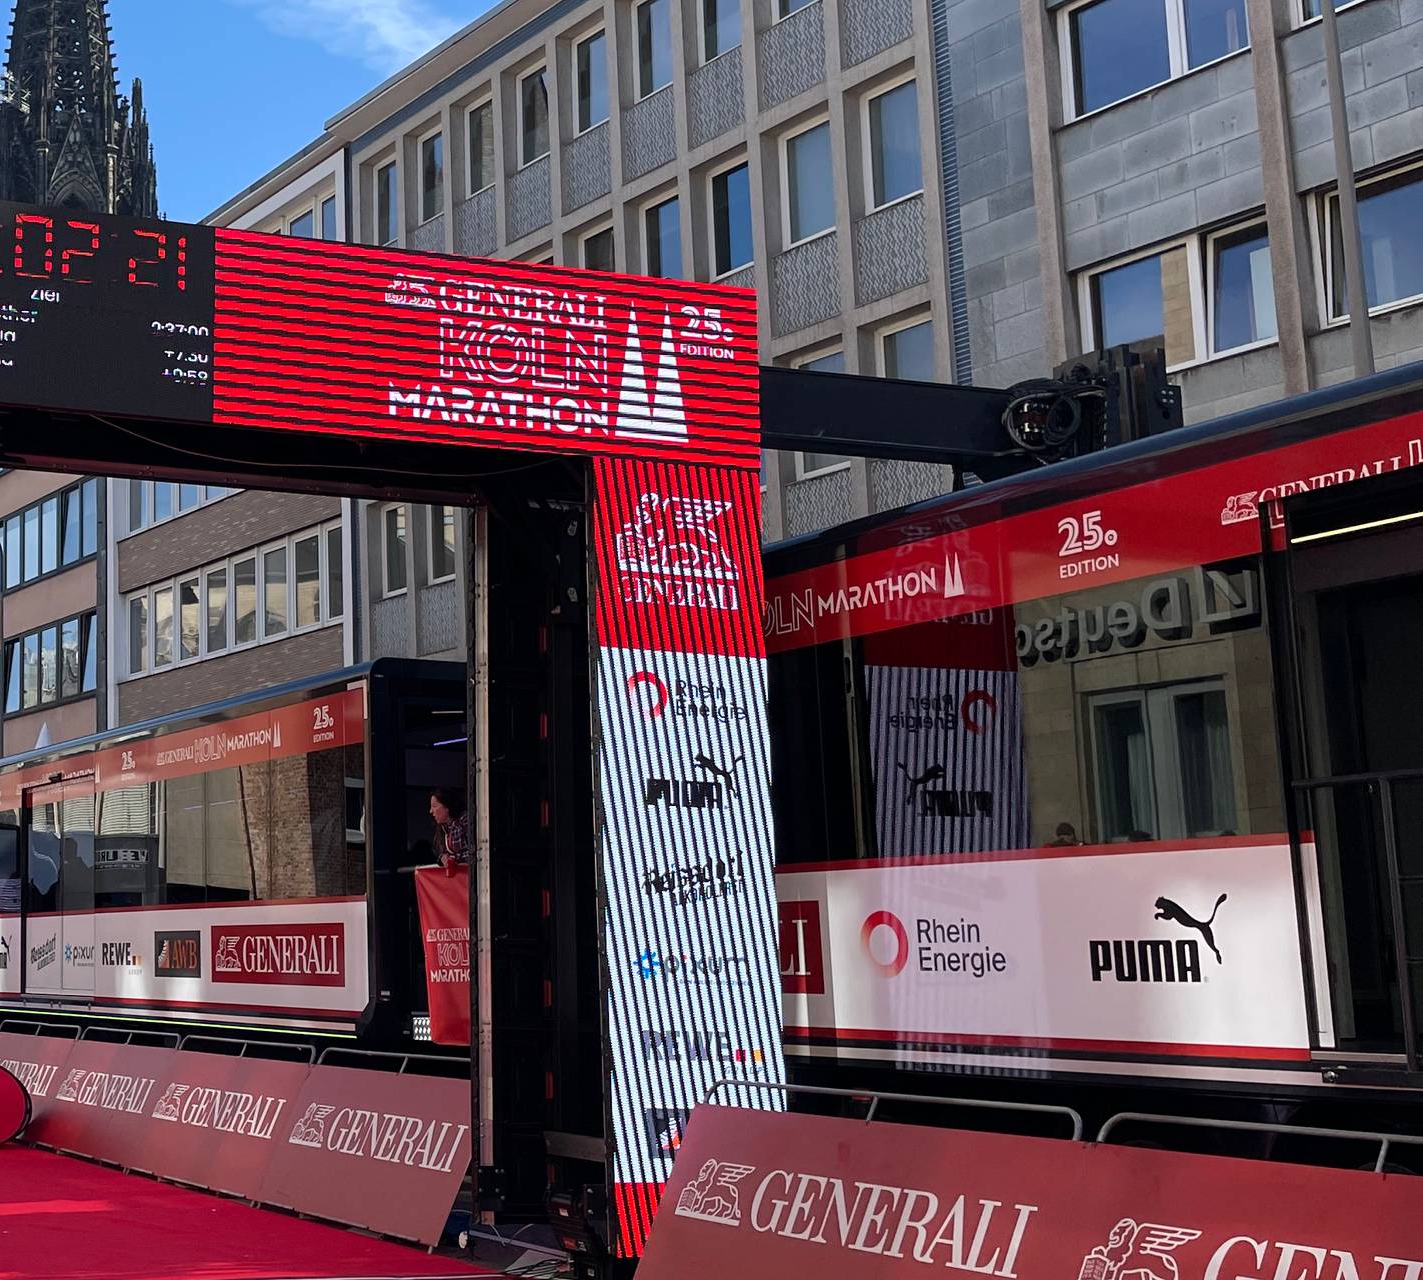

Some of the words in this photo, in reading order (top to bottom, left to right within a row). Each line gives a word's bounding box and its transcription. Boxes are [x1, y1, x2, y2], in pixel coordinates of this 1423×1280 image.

[439, 280, 607, 328] GENERALI
[681, 343, 735, 360] EDITION
[387, 382, 609, 437] MARATHON
[1060, 553, 1120, 579] EDITION
[618, 575, 739, 611] GENERALI
[817, 567, 937, 617] MARATHON
[677, 679, 728, 700] Rhein
[676, 700, 747, 723] Energie
[227, 727, 272, 752] MARATHON
[917, 918, 980, 944] Rhein
[101, 942, 131, 966] REWE
[171, 939, 198, 969] AWB
[242, 934, 340, 975] GENERALI
[918, 946, 1007, 978] Energie
[1089, 940, 1202, 982] PUMA
[643, 1029, 730, 1062] REWE
[76, 1071, 156, 1115] GENERALI
[180, 1086, 286, 1140] GENERALI
[326, 1107, 469, 1173] GENERALI
[750, 1169, 1039, 1279] GENERALI
